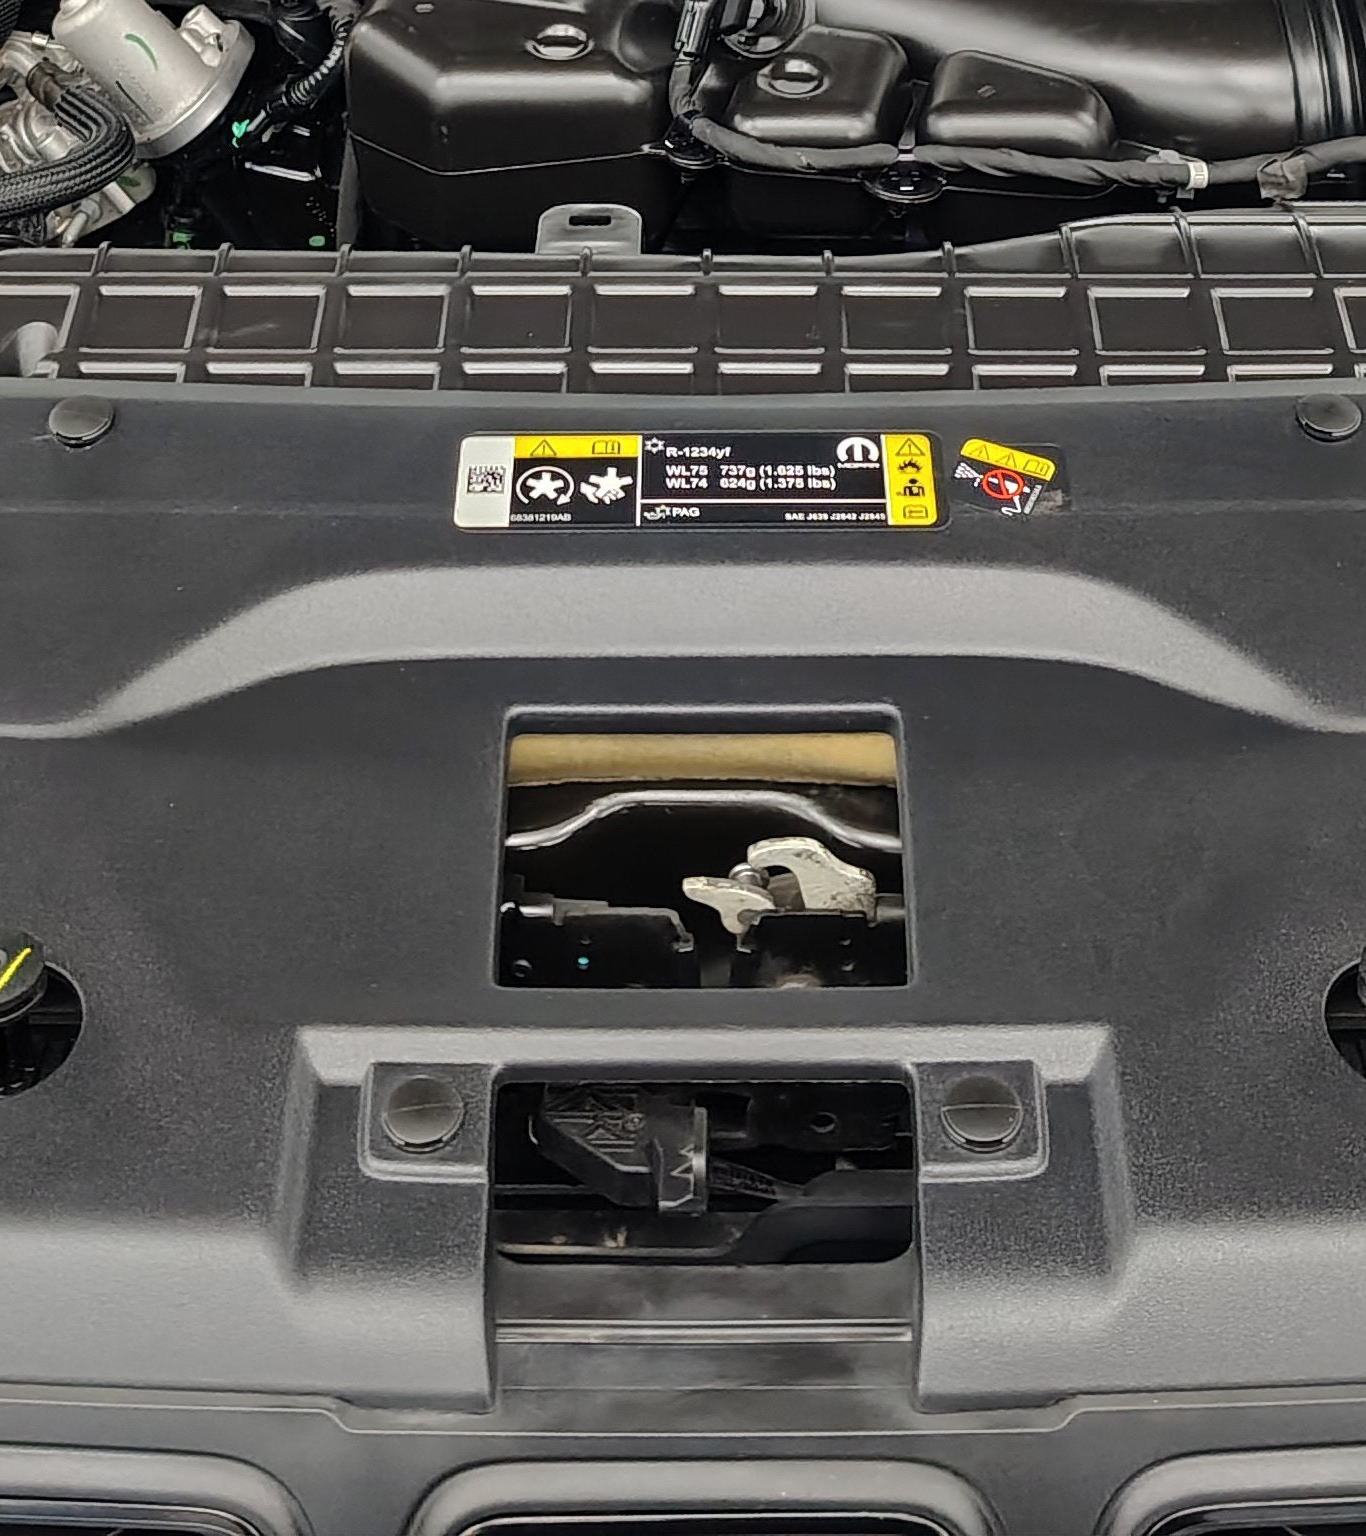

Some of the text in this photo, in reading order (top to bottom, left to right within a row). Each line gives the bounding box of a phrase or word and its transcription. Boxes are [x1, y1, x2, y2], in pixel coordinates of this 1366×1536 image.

[666, 446, 732, 459] R-1234yf
[666, 465, 709, 476] WL75
[720, 465, 756, 478] 737g
[807, 465, 835, 478] lbs)
[666, 477, 709, 489] WL74
[759, 477, 804, 490] (1.375
[807, 477, 836, 490] lbs)
[672, 507, 701, 518] PAG
